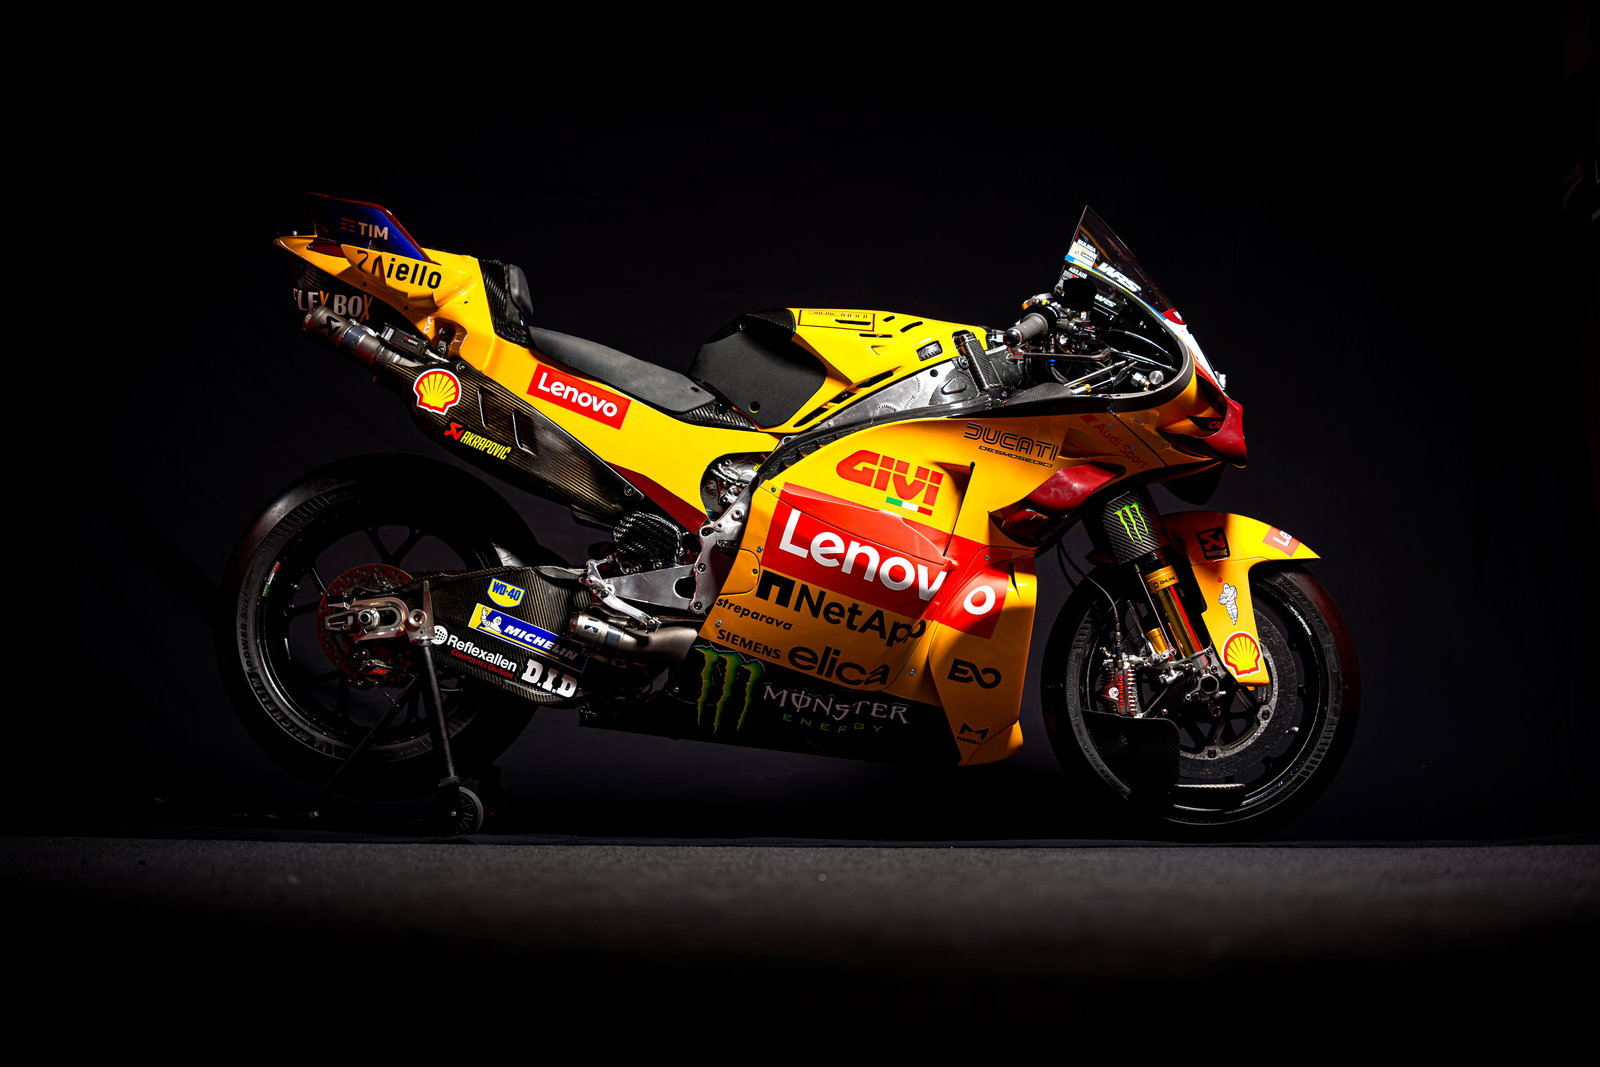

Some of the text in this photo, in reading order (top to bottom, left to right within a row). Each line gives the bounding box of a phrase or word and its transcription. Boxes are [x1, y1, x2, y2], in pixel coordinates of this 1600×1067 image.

[358, 222, 389, 241] TIM
[1098, 262, 1142, 293] WRS
[333, 293, 374, 322] BOX
[537, 371, 618, 418] Lenovo
[964, 421, 1060, 462] DUCATI
[979, 444, 1054, 468] DESMOSEDICI
[1095, 423, 1149, 470] Audi Sport
[836, 449, 944, 506] GIVI
[777, 508, 997, 616] Lenovo
[492, 580, 522, 602] WD-40
[716, 598, 794, 631] streparava
[794, 583, 928, 648] NetApp
[446, 633, 518, 674] Reflexallen
[504, 624, 579, 662] MICHELIN
[716, 628, 783, 661] SIEMENS
[787, 645, 891, 688] elica
[761, 683, 911, 726] MONSTER
[782, 712, 885, 736] ENERGY
